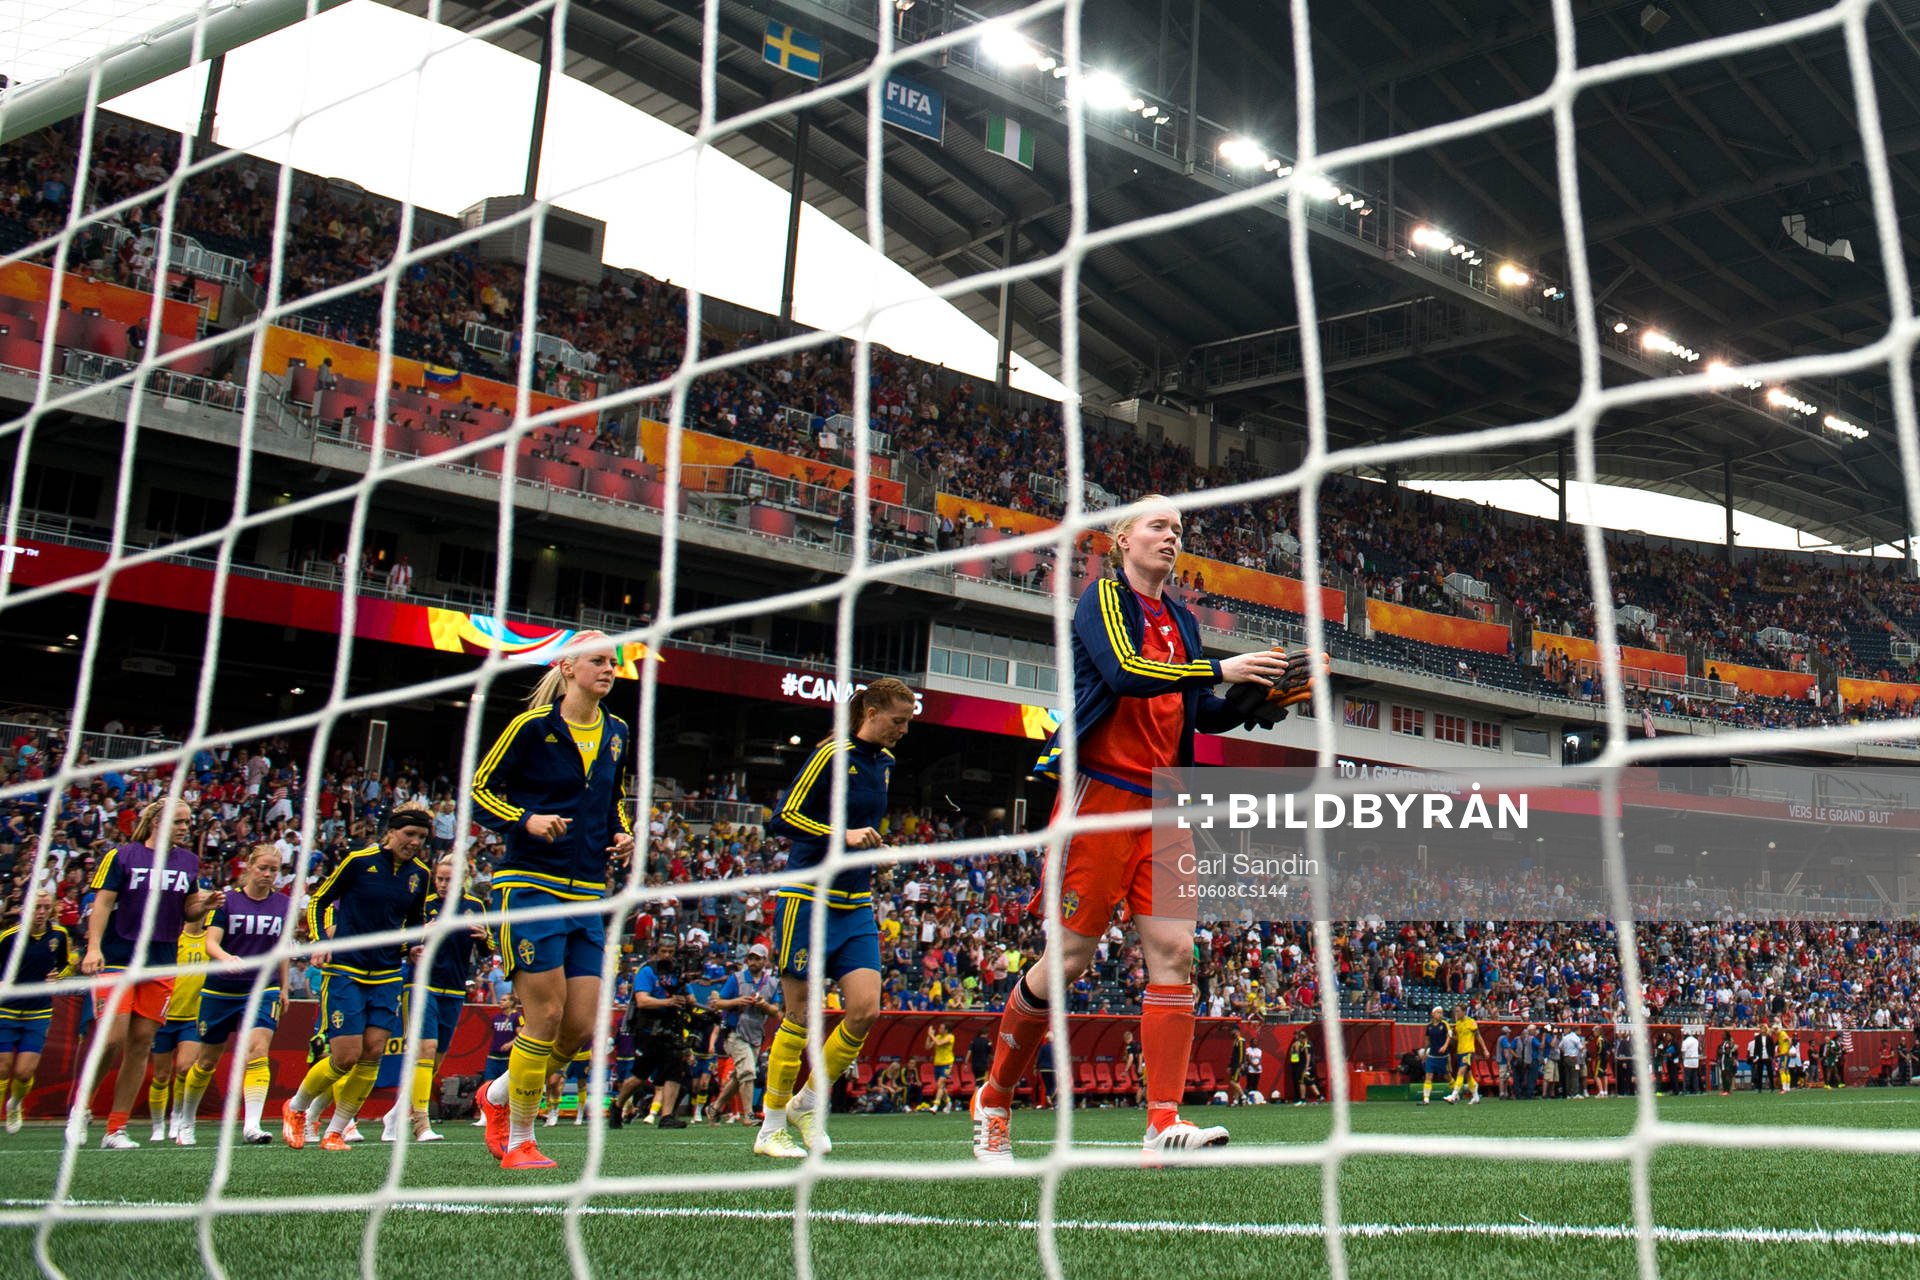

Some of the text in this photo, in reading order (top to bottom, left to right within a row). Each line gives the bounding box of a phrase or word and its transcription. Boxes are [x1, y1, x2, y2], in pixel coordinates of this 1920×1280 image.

[887, 81, 932, 116] FIFA
[1338, 760, 1357, 779] TO
[1360, 764, 1370, 781] A
[1430, 774, 1461, 795] GOAL
[1789, 804, 1813, 819] VERS
[1815, 807, 1826, 820] LE
[1829, 808, 1865, 823] GRAND
[229, 914, 283, 936] FIFA
